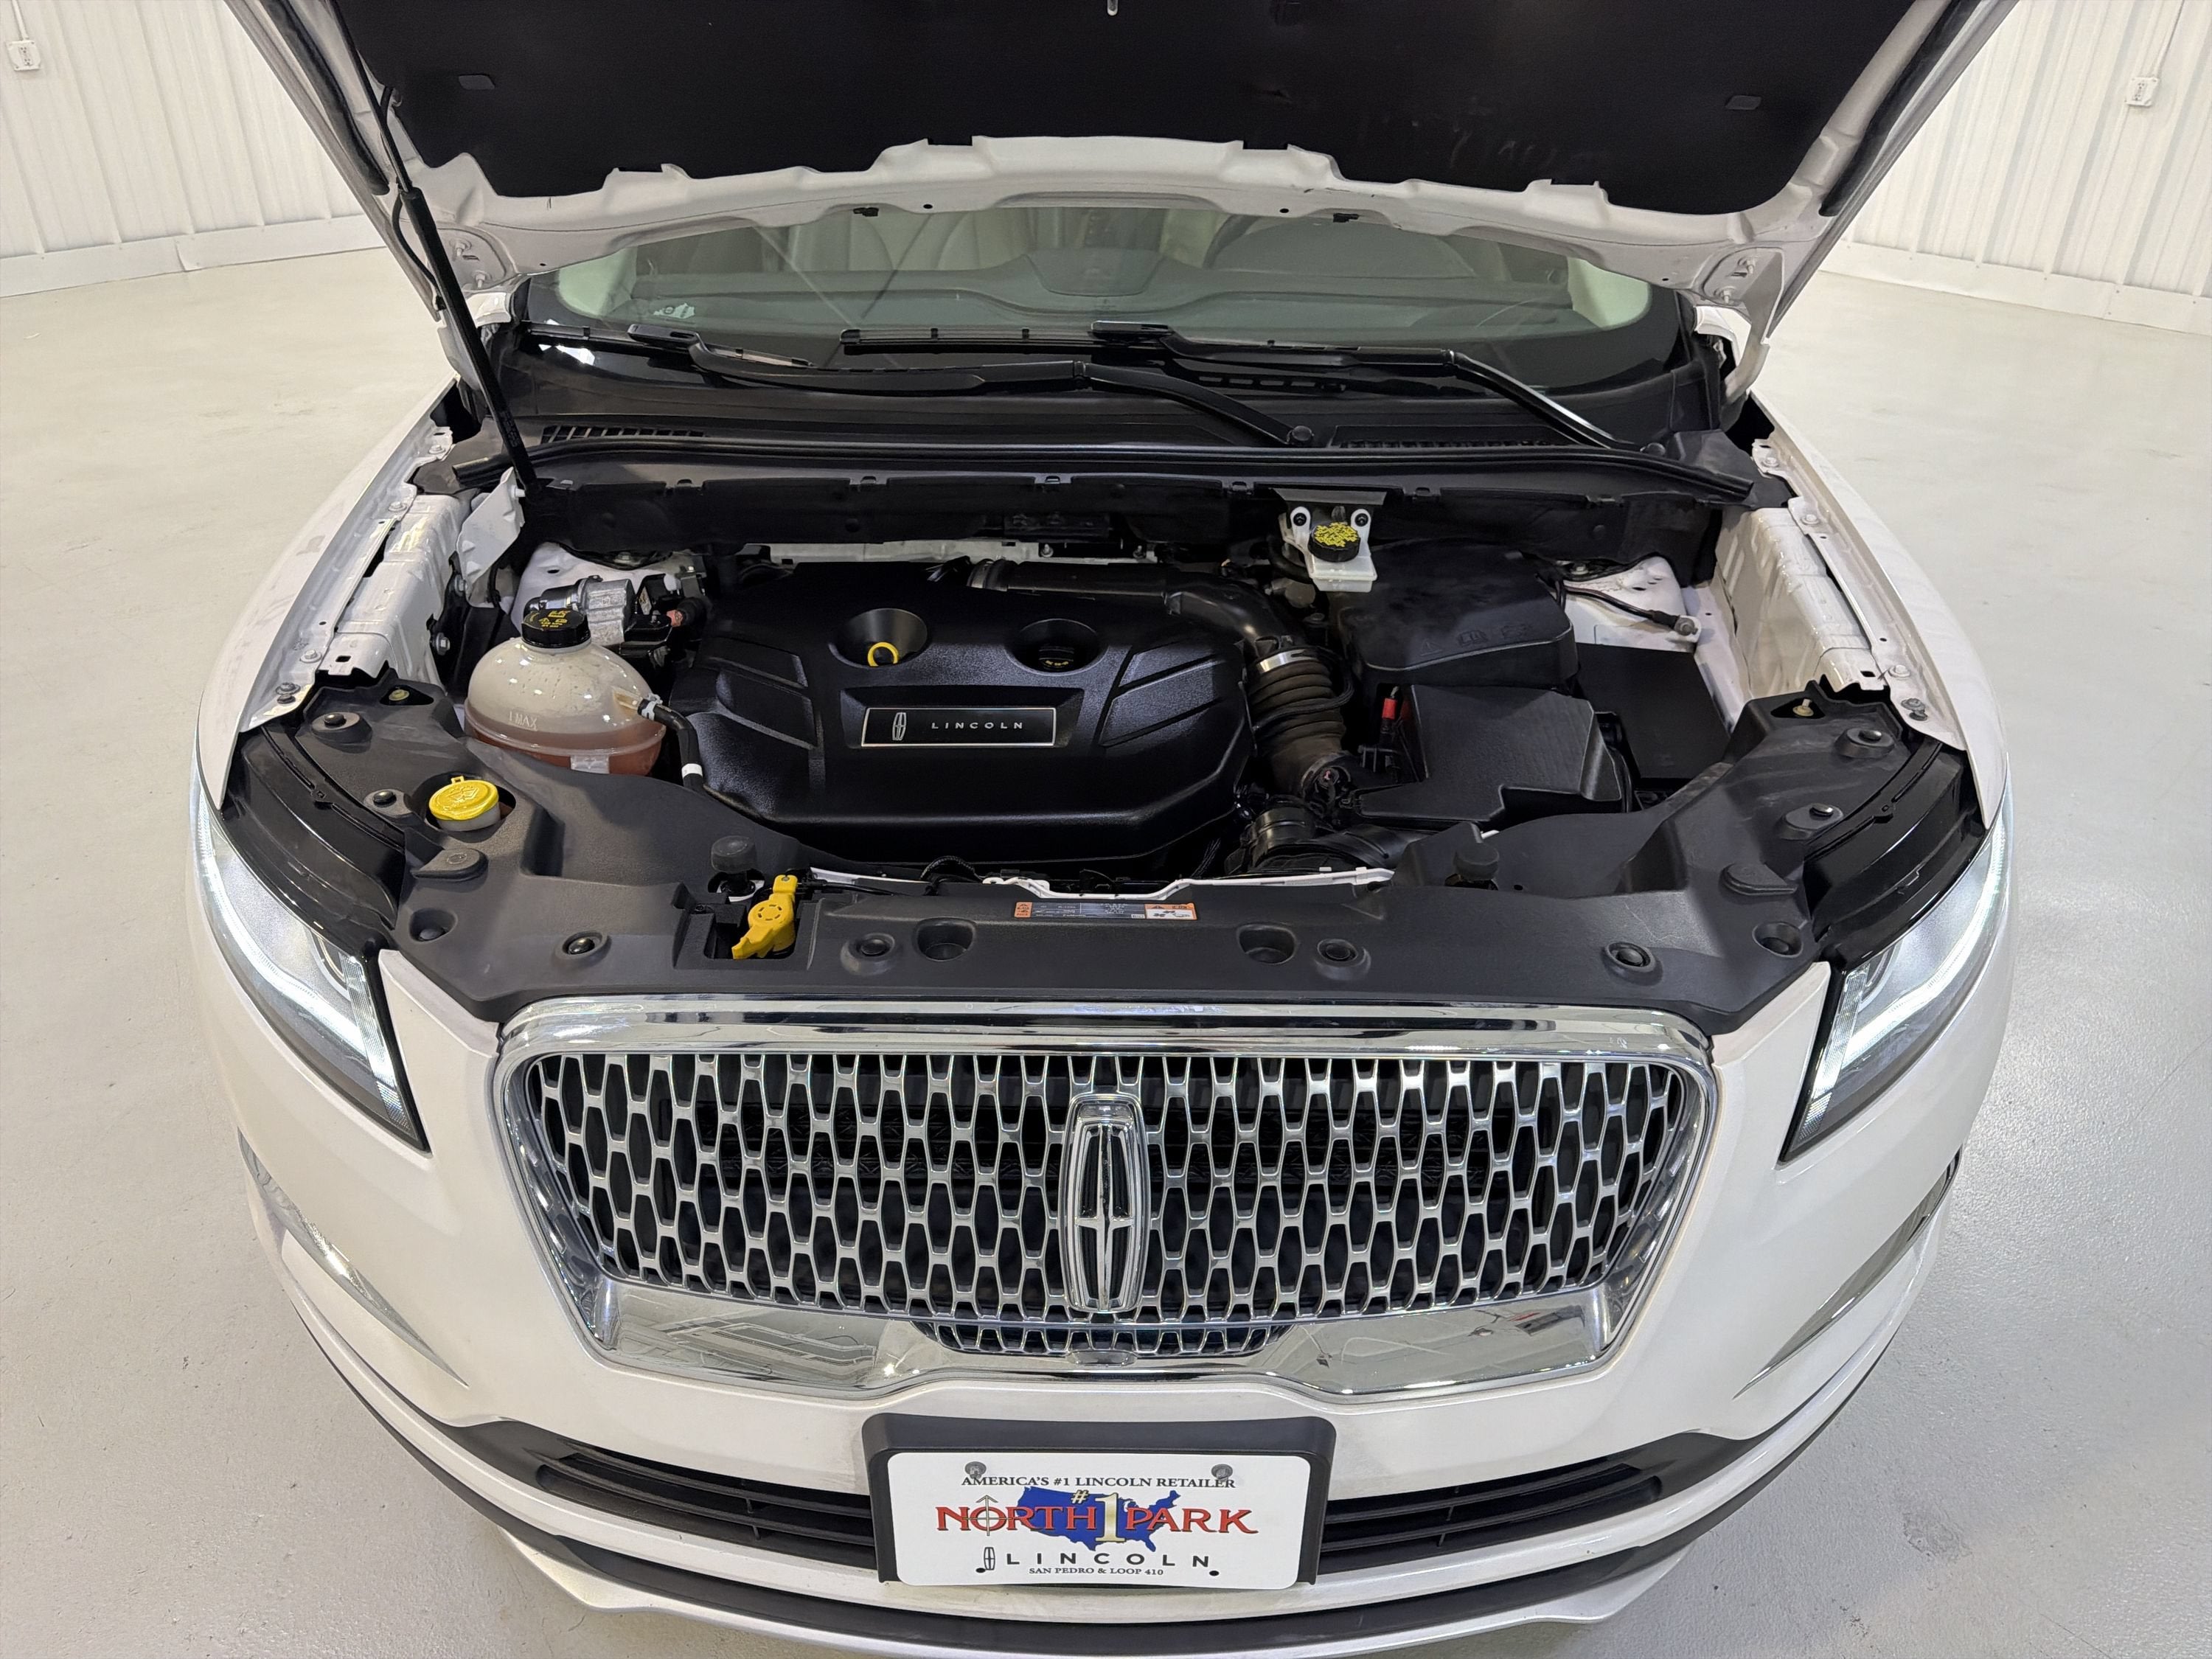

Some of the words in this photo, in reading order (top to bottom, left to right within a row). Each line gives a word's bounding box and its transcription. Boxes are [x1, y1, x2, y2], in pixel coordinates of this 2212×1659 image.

[515, 712, 538, 732] MAX
[961, 1476, 1049, 1486] AMERICA'S
[1053, 1477, 1070, 1486] #1
[1075, 1477, 1152, 1487] LINCOLN
[1155, 1478, 1236, 1489] RETAILER
[935, 1506, 1097, 1531] NORTH
[1125, 1506, 1259, 1534] PARK
[1006, 1552, 1209, 1568] LINCOLN
